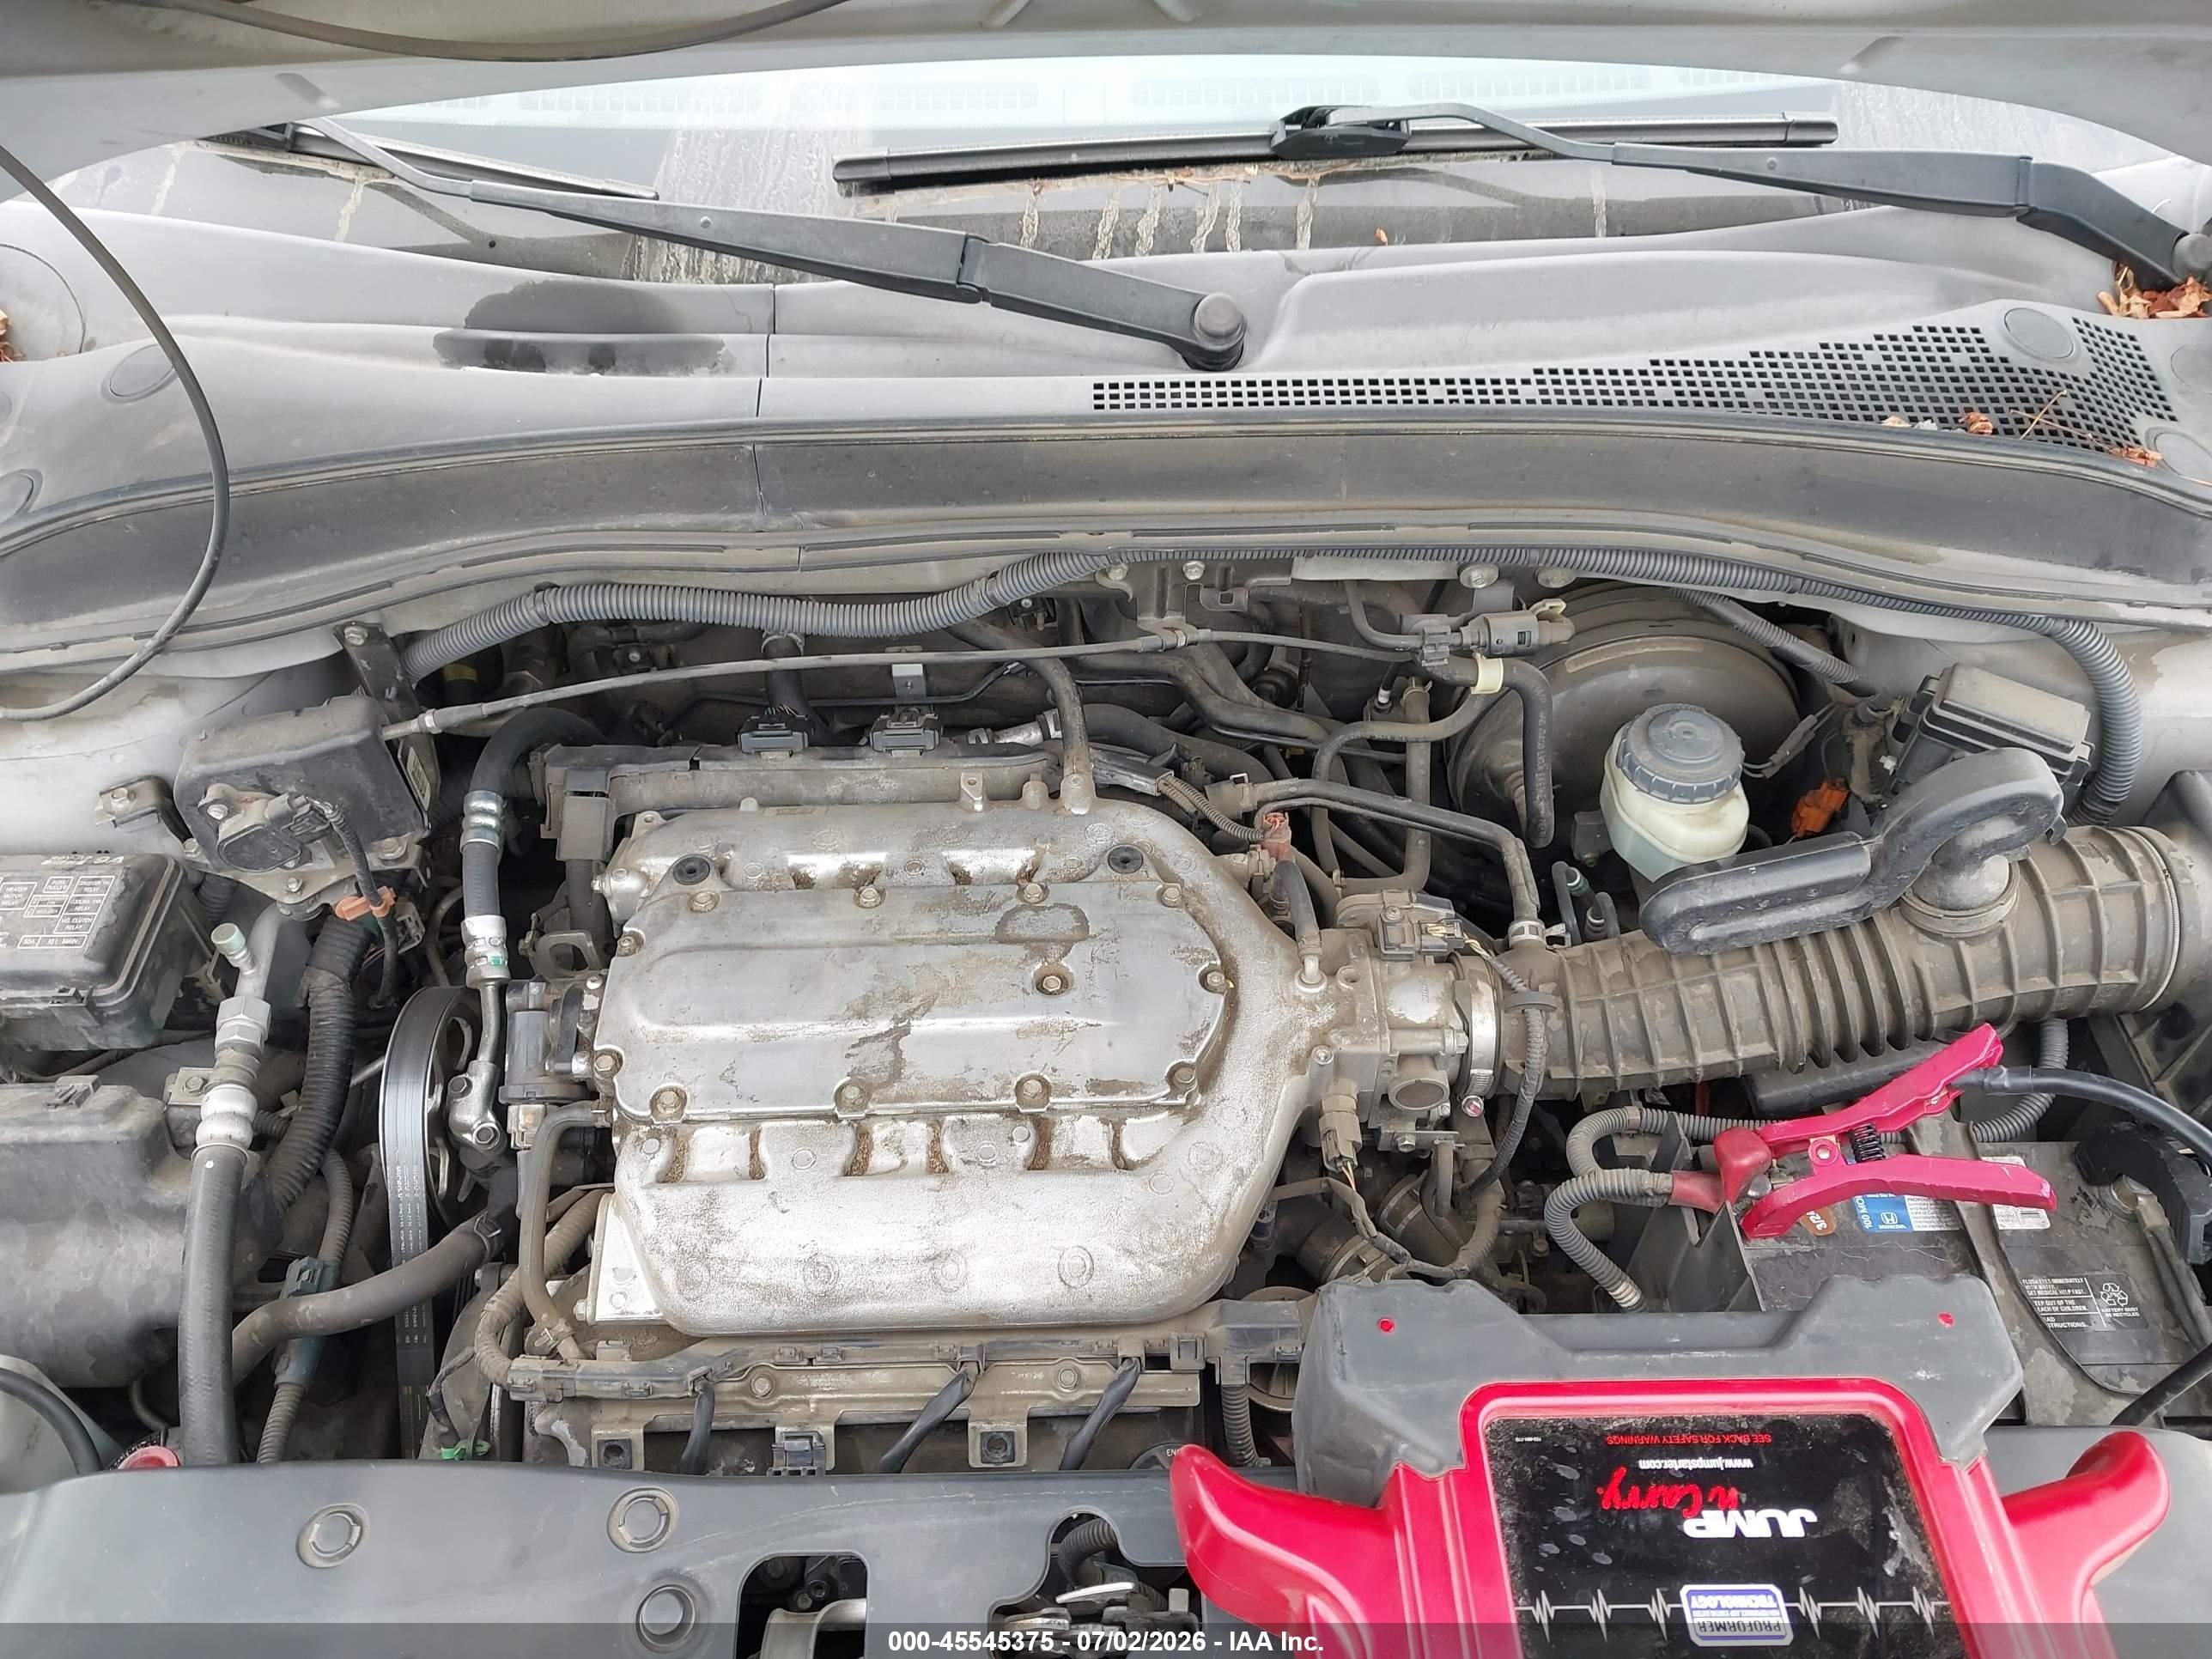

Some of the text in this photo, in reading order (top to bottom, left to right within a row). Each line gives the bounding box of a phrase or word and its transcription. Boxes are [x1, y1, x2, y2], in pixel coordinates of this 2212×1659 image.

[1862, 1214, 1874, 1230] 100
[1606, 1433, 1772, 1445] SEE BACK FOR SAFETY WARNINGS
[1638, 1456, 1754, 1471] www.jumpstarter.com
[1682, 1508, 1818, 1540] JUMP
[1697, 1620, 1782, 1633] PROFORMER
